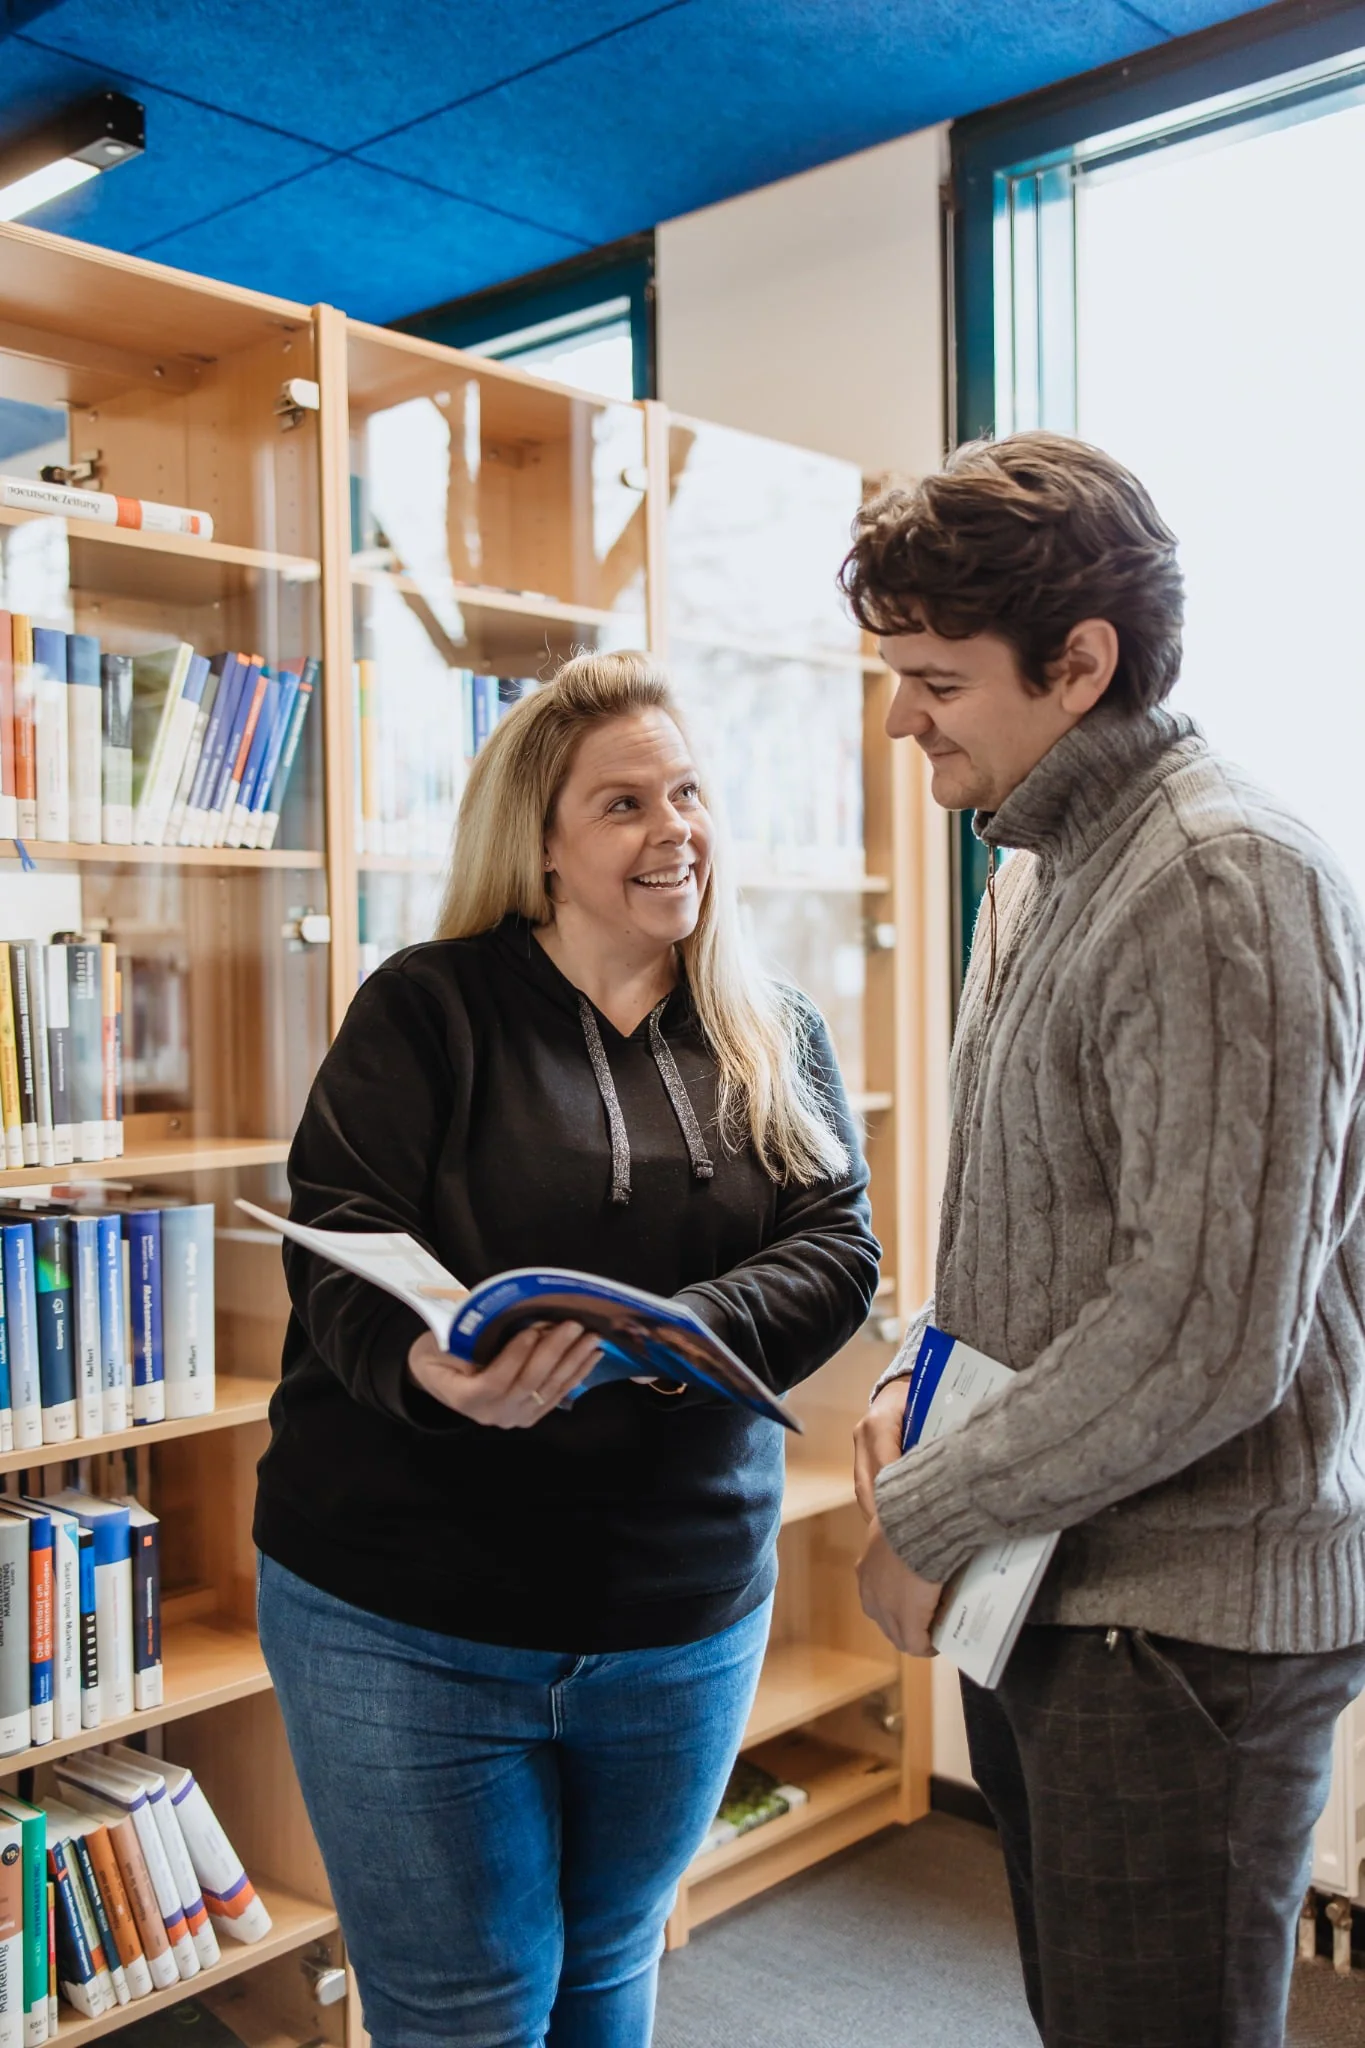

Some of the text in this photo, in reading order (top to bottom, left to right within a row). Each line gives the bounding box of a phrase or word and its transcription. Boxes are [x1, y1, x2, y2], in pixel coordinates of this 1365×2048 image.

[62, 495, 101, 514] Zeitung
[142, 1284, 153, 1383] Markenmanagement
[86, 1348, 95, 1377] Meffert
[188, 1345, 197, 1378] Meffert
[924, 1348, 933, 1367] ahead
[2, 1563, 10, 1617] MARKETING
[64, 1561, 72, 1590] Search
[43, 1560, 51, 1635] Internet-Kunden
[64, 1591, 73, 1620] Engine
[36, 1584, 45, 1658] Der Wettlauf um
[953, 1605, 967, 1639] Fragen?
[0, 1944, 9, 2013] Marketing
